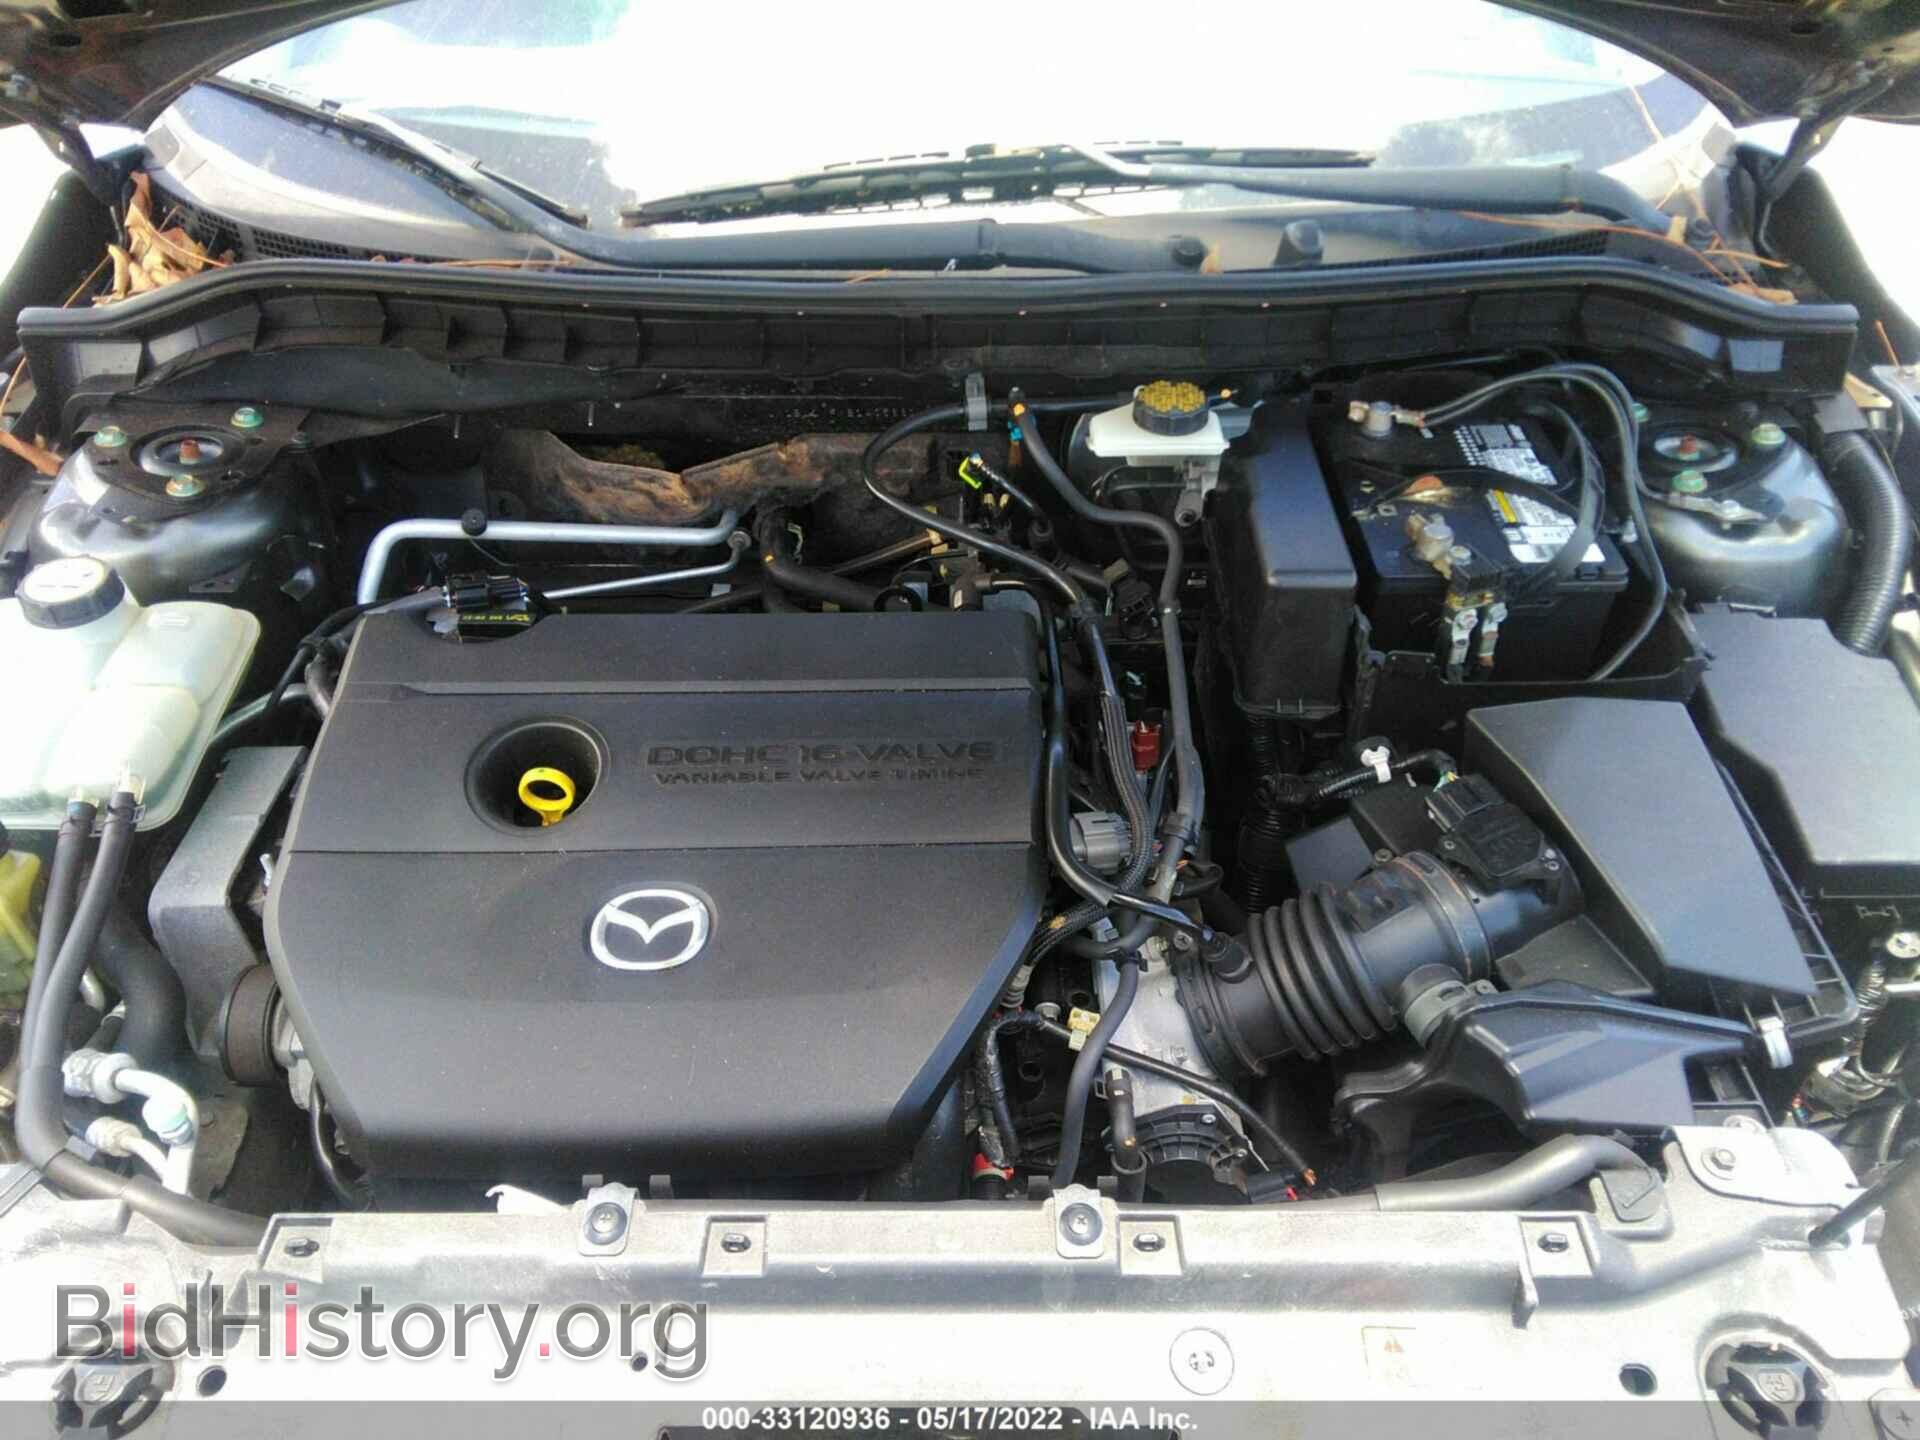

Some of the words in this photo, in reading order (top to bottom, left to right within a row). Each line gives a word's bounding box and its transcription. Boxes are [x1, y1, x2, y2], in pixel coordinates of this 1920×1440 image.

[648, 745, 787, 766] DOHC
[656, 770, 790, 784] VARIABLE
[800, 769, 881, 782] VALVE
